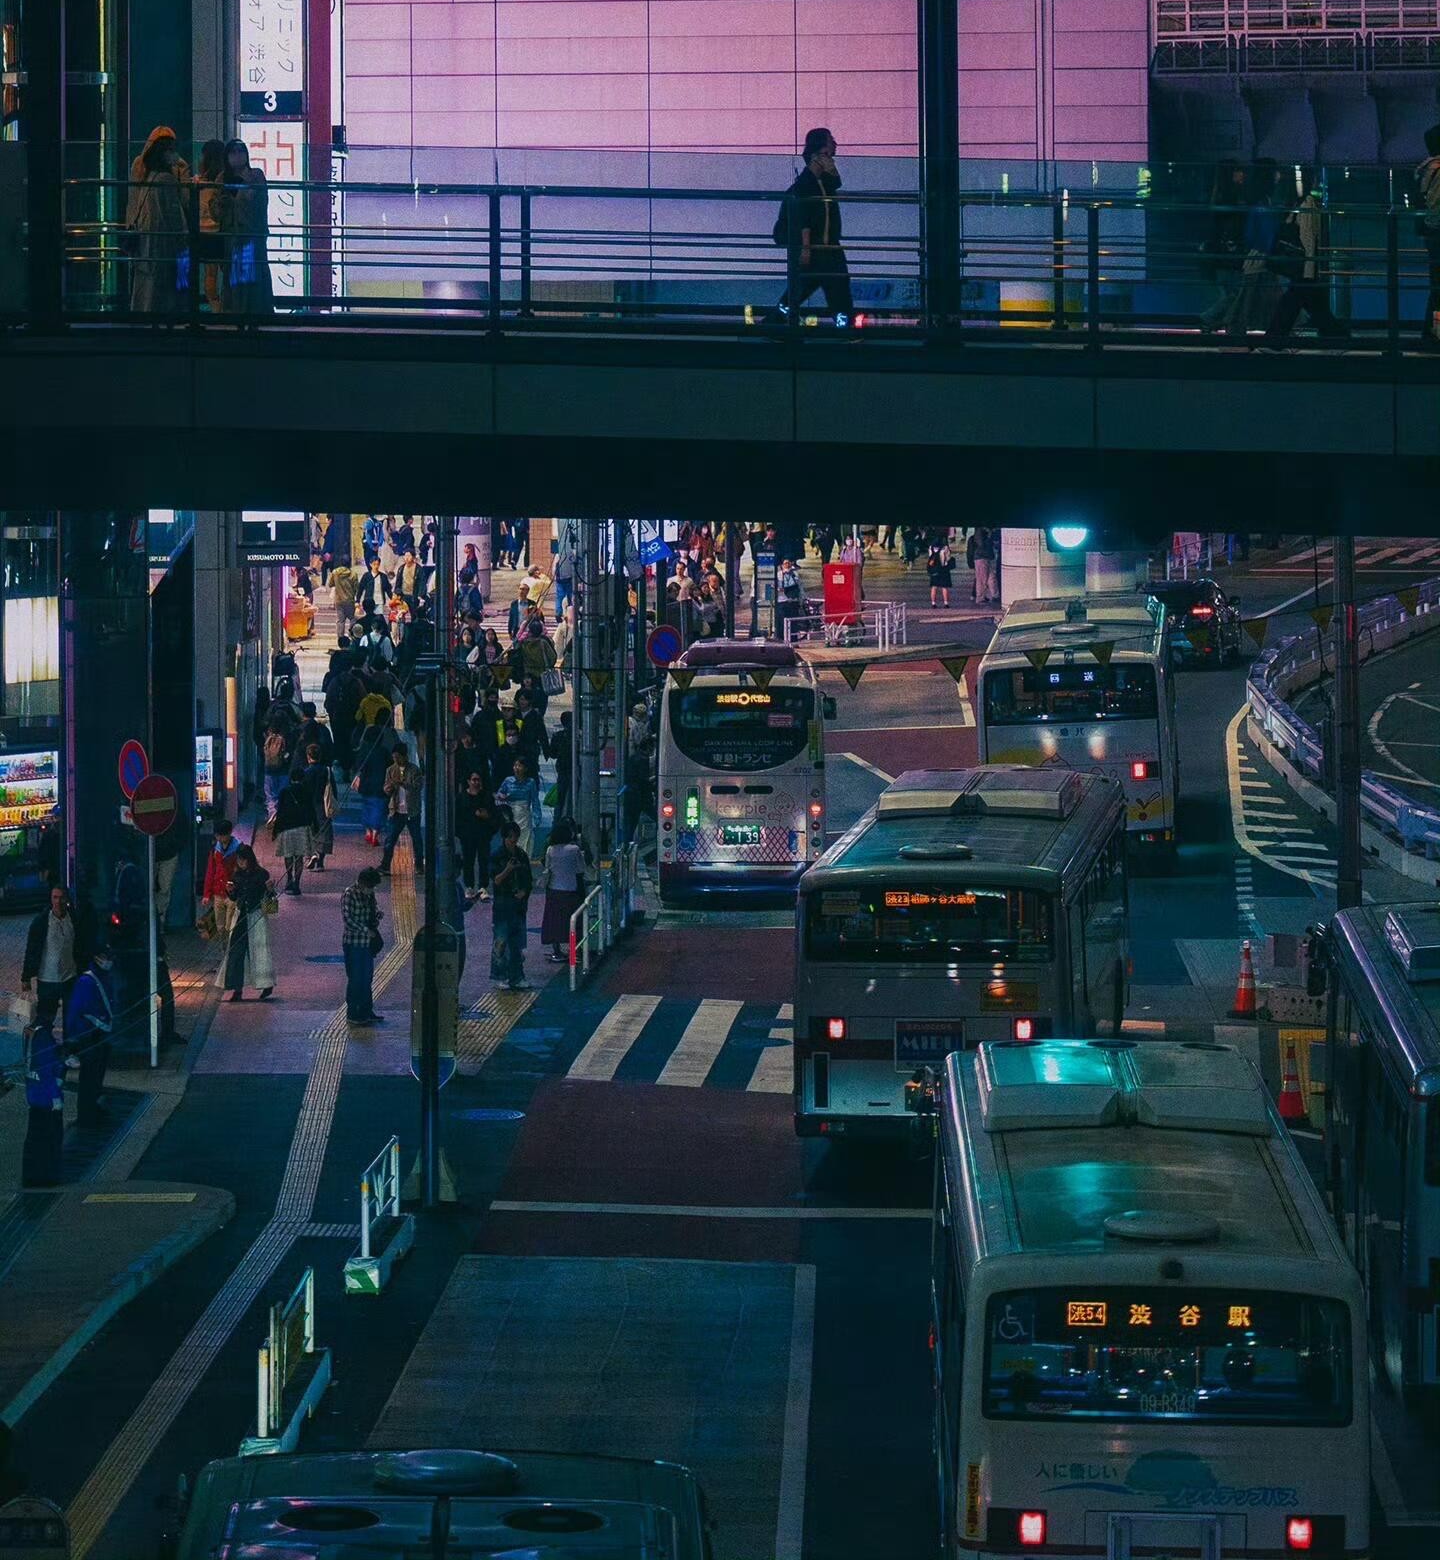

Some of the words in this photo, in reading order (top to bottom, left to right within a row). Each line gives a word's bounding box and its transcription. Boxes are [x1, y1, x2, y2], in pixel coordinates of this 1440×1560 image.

[263, 90, 278, 112] 3
[277, 192, 295, 288] クリニック
[266, 520, 276, 541] 1
[715, 801, 768, 817] kewpie
[1070, 1305, 1104, 1321] 渋54
[1128, 1303, 1253, 1328] 渋谷駅
[1035, 1462, 1118, 1480] 人に優しい
[1173, 1486, 1300, 1507] ノンステップバス
